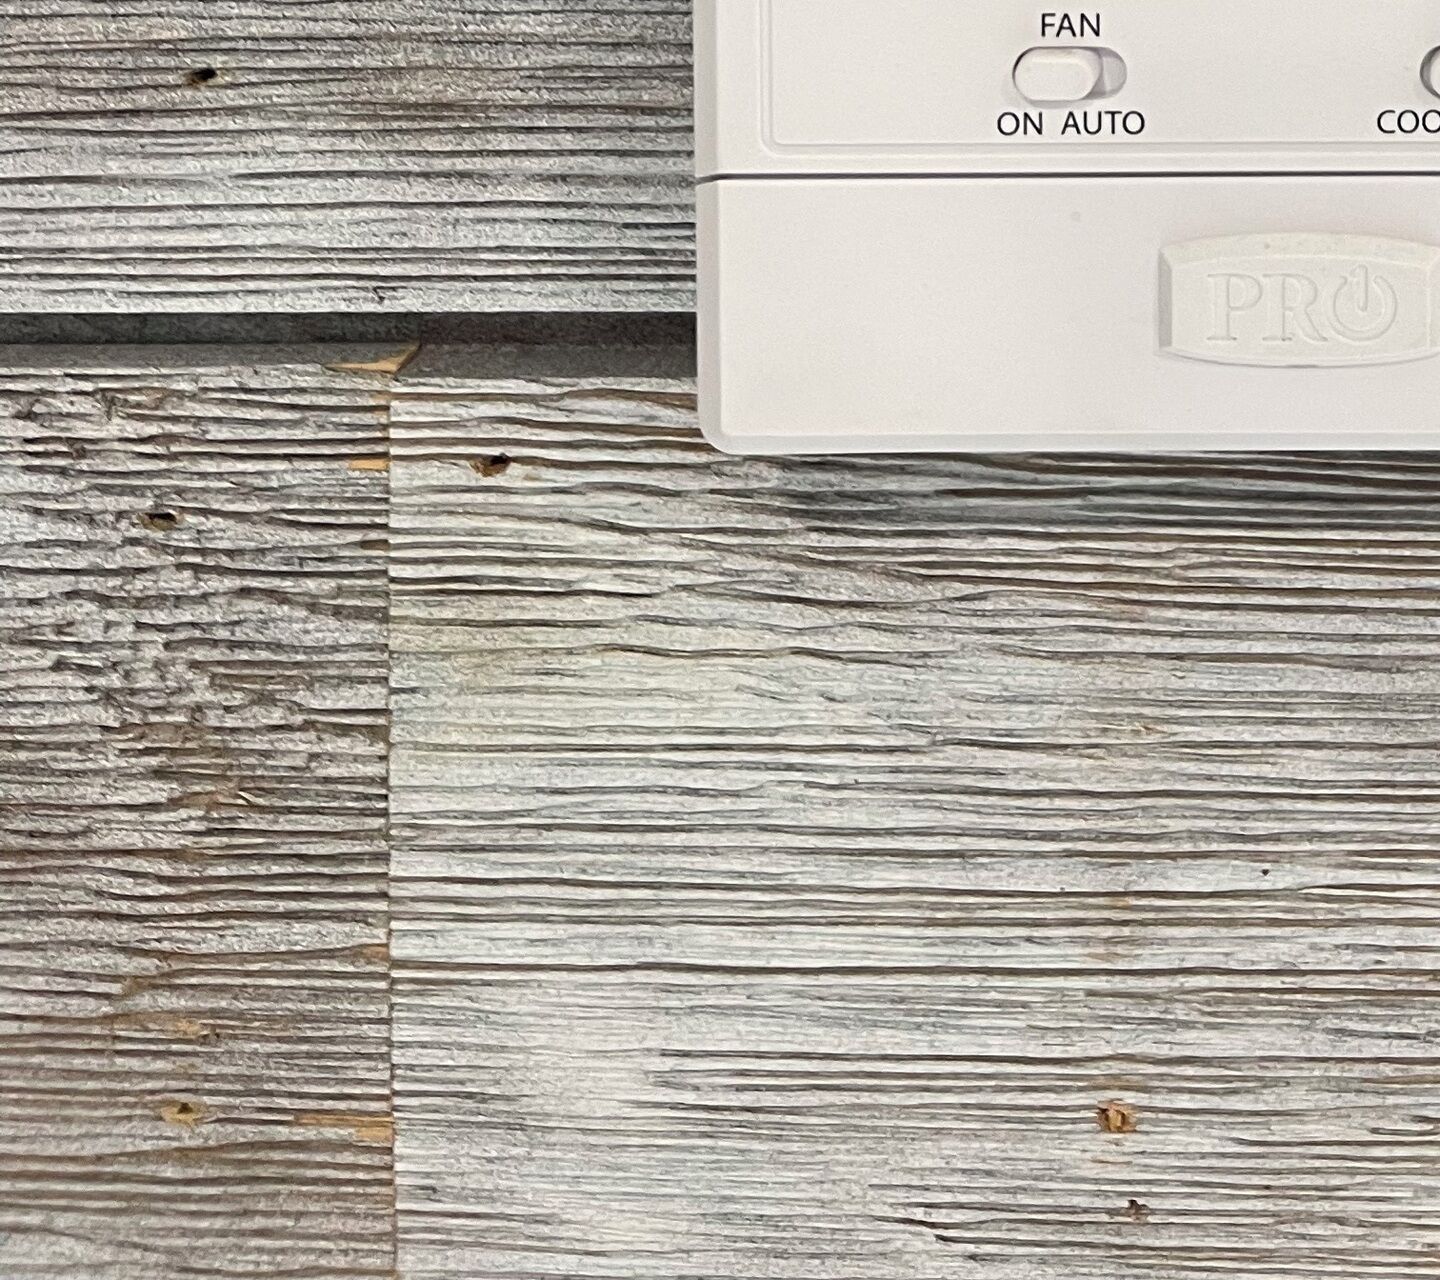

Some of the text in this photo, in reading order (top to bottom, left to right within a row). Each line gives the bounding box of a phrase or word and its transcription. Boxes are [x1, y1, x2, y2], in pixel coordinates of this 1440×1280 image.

[1040, 13, 1102, 38] FAN
[996, 110, 1146, 137] ON AUTO
[1206, 263, 1399, 342] PRO
